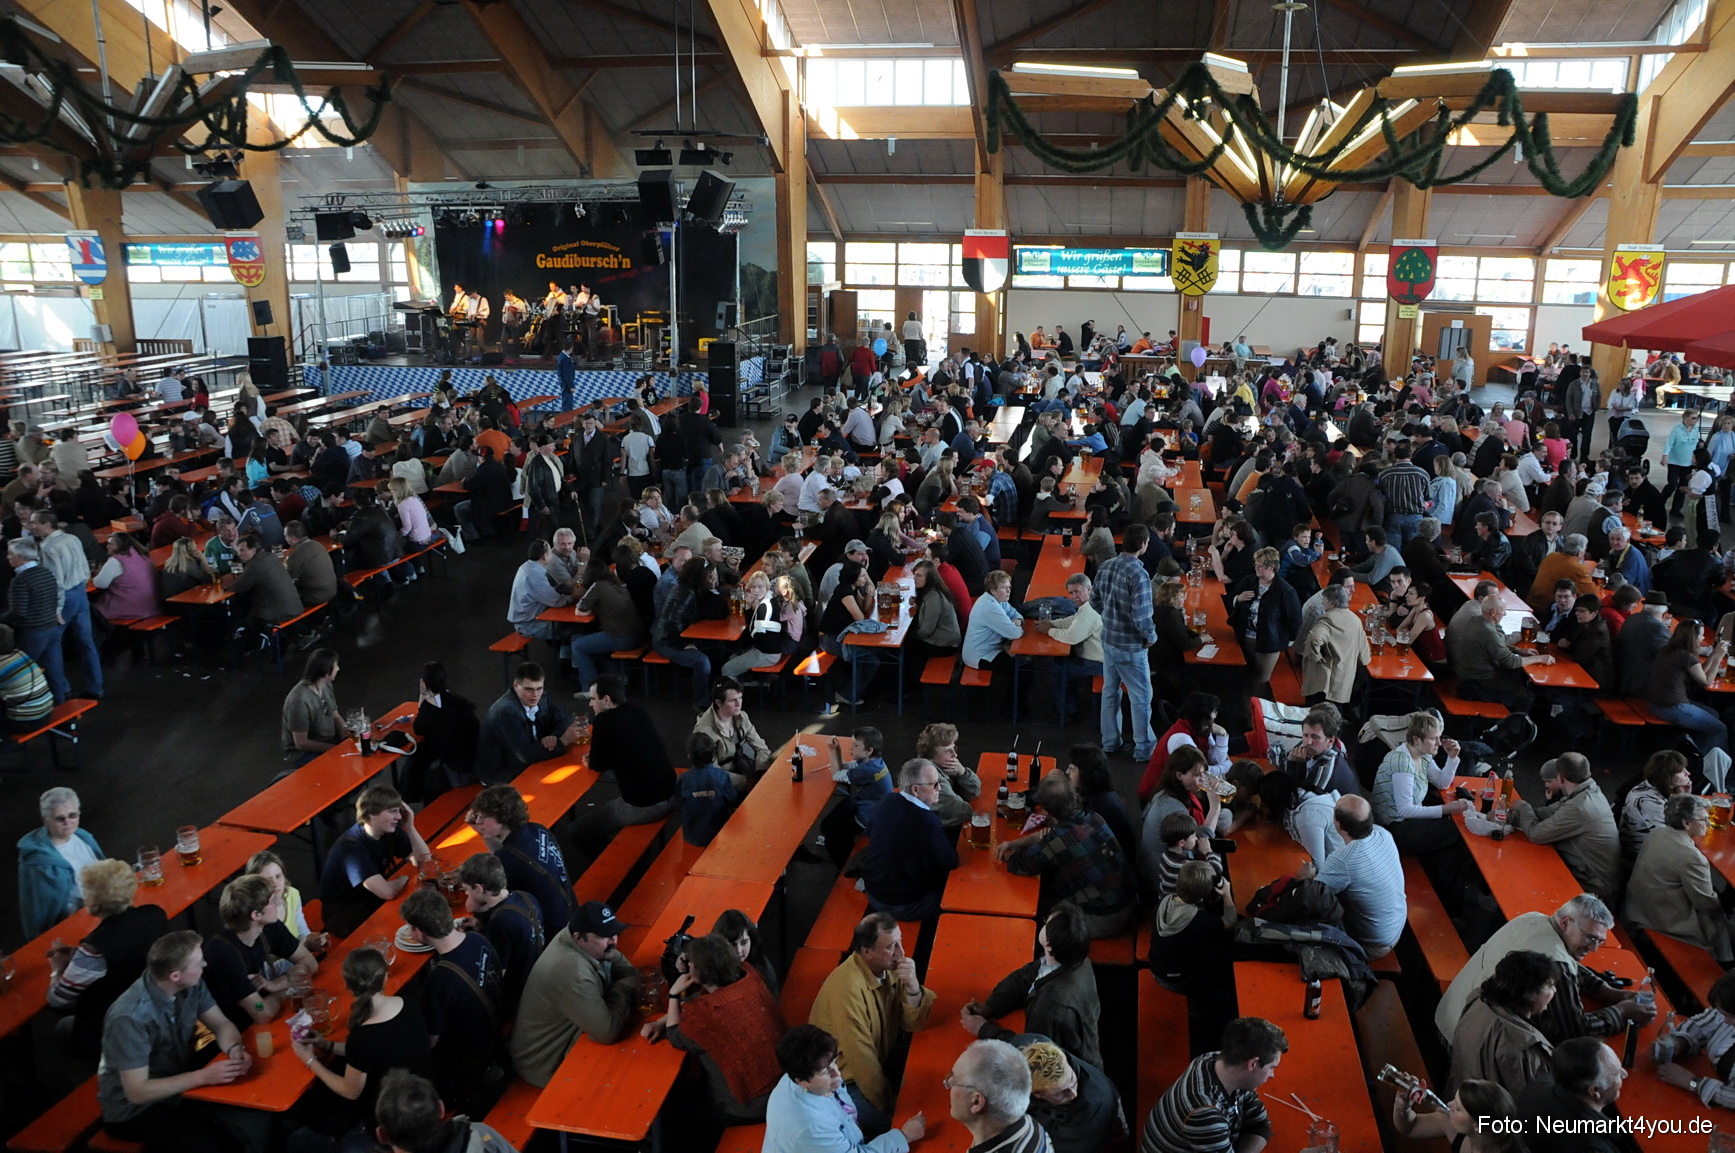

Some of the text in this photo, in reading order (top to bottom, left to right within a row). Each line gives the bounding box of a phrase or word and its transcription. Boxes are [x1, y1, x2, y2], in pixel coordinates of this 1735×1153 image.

[157, 245, 175, 254] Wir
[552, 240, 621, 252] Original Oberpfälzer
[536, 253, 632, 269] Gaudibursch'n
[1060, 249, 1122, 265] Wir grüßen
[1056, 263, 1127, 275] unsere Gäste!
